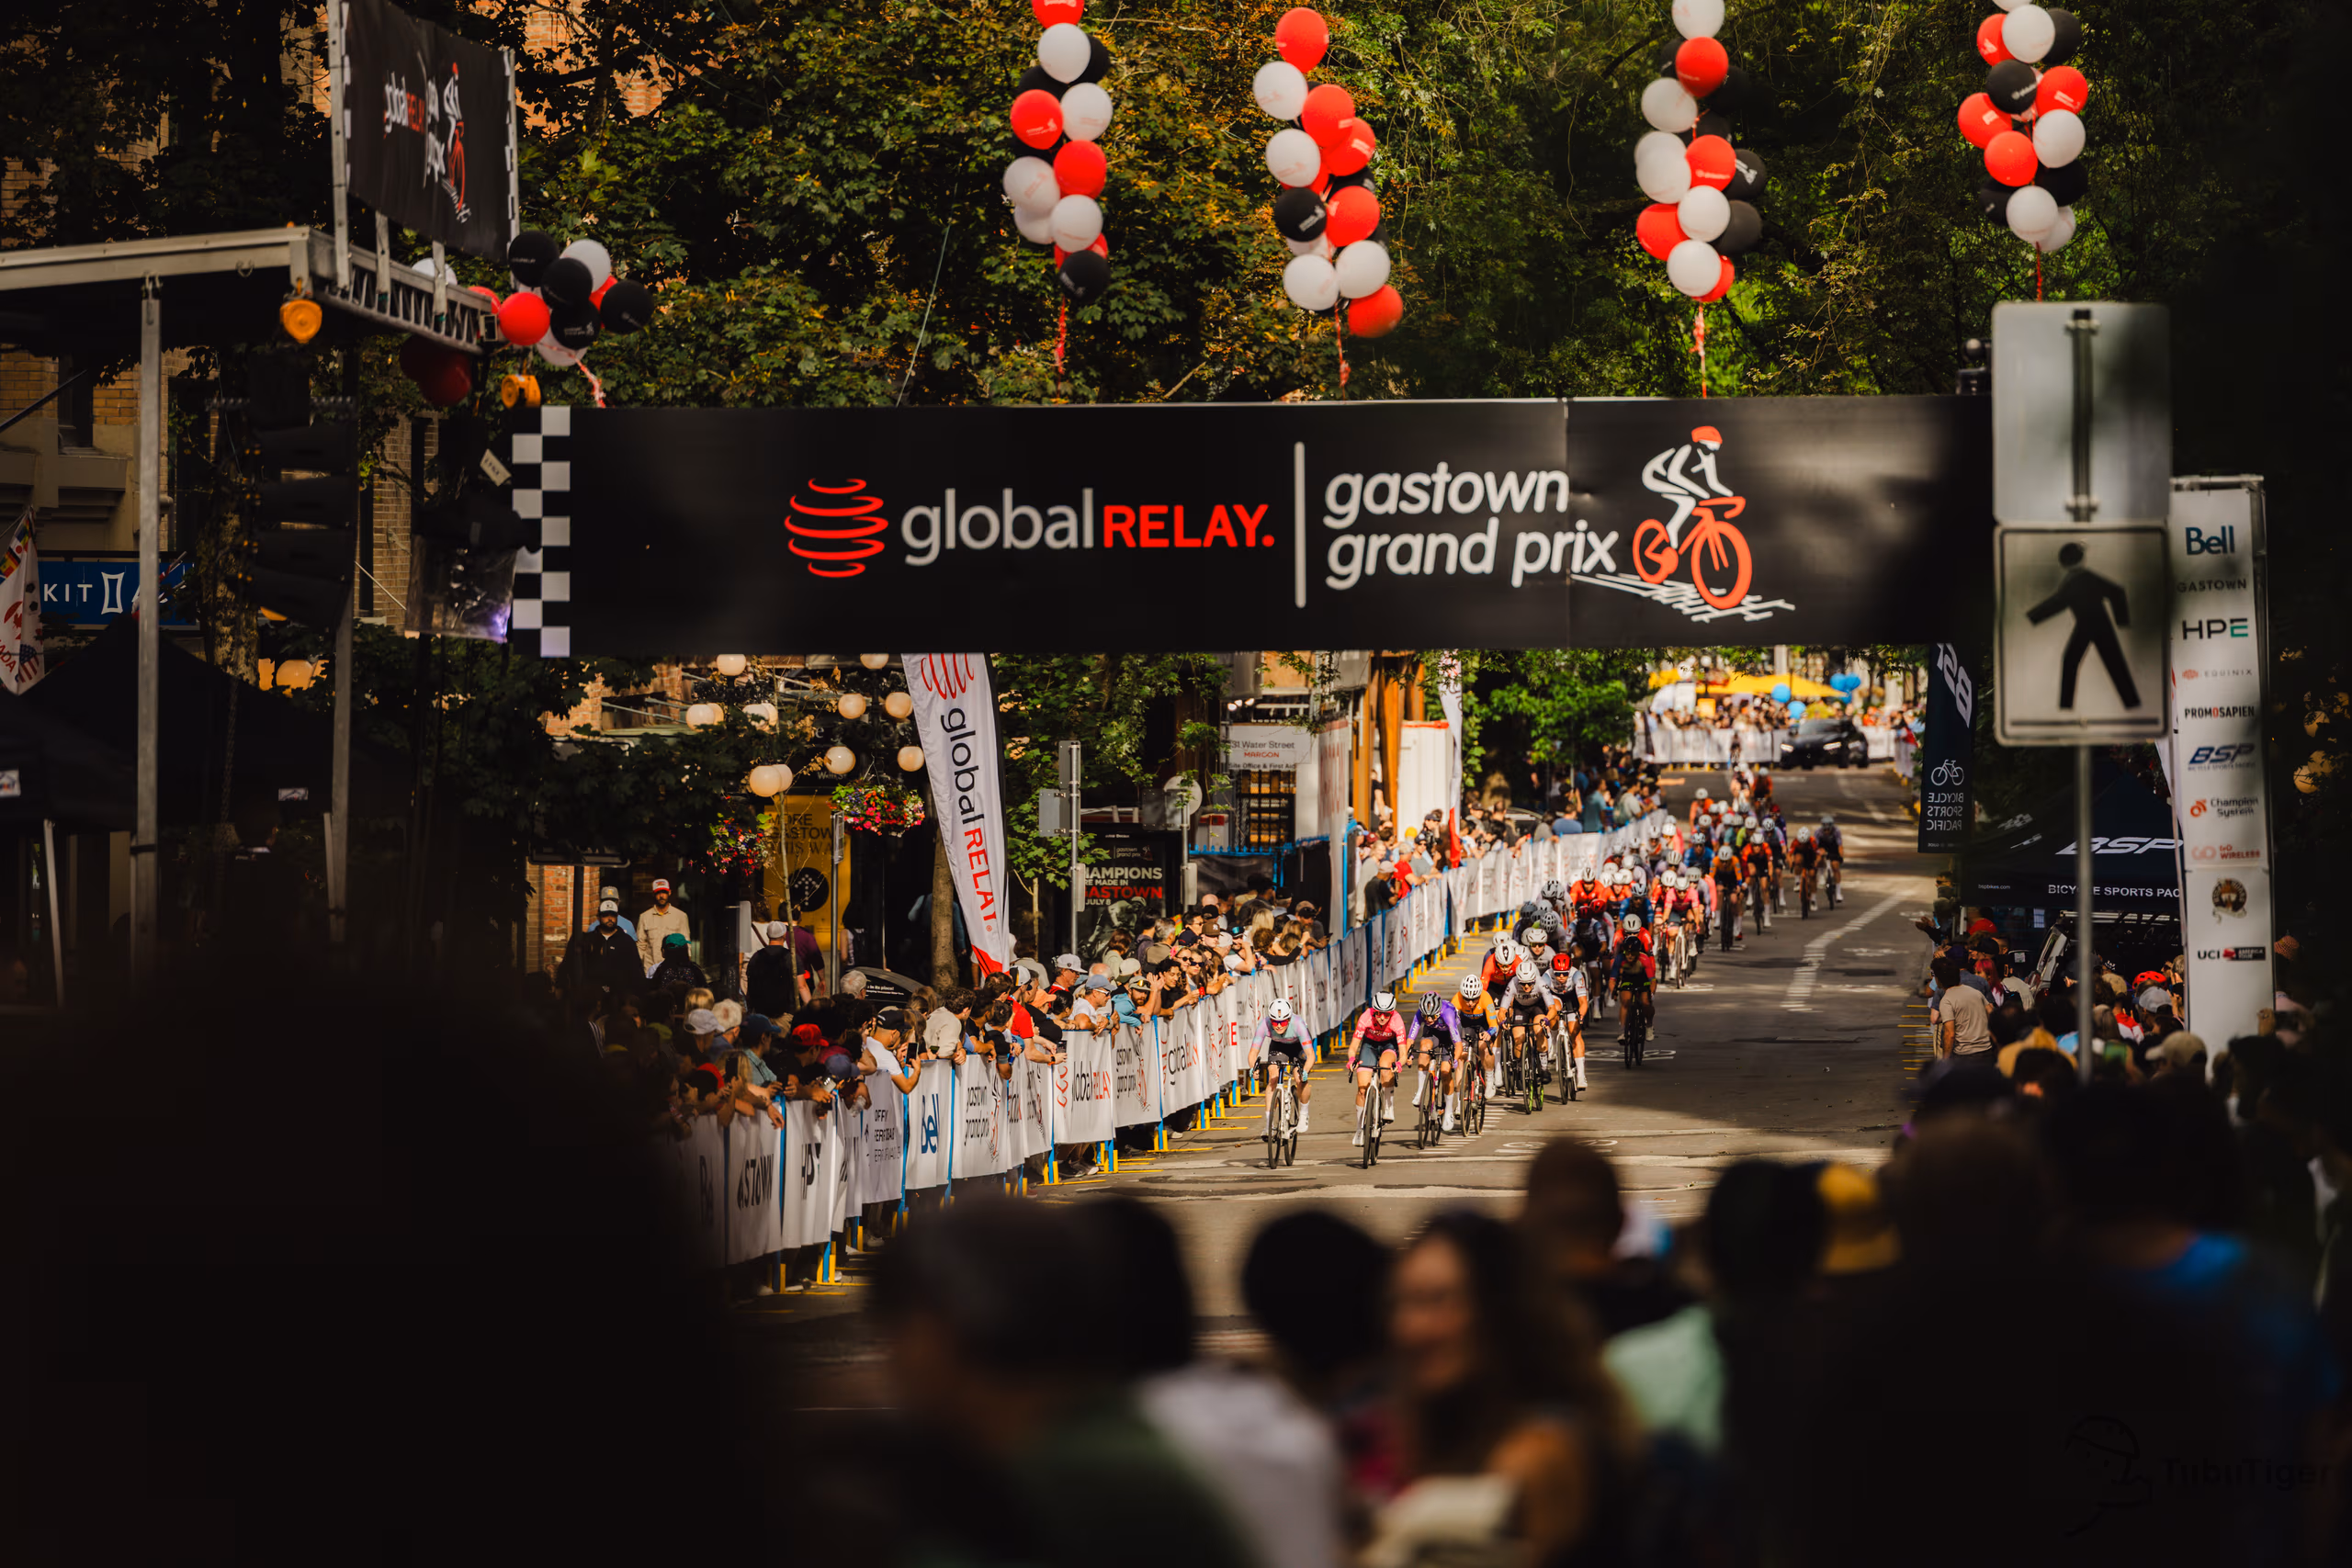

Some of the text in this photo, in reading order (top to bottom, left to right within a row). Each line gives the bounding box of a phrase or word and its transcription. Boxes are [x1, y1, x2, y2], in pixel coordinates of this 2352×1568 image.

[1323, 461, 1569, 530] gastown
[2185, 525, 2235, 556] Bell
[1326, 516, 1619, 590] grand prix
[43, 583, 93, 603] KIT
[2177, 579, 2247, 593] GASTOWN
[2182, 617, 2248, 640] HPE
[2204, 669, 2253, 678] EQUINIX
[2184, 705, 2255, 719] PROMOSAPIEN
[1242, 740, 1266, 749] Water
[1269, 740, 1295, 749] Street
[2188, 743, 2255, 764] BSP
[2055, 836, 2184, 855] BSP
[1085, 867, 1163, 880] HAMPIONS
[2104, 886, 2154, 897] SPORTS
[2198, 949, 2221, 960] UCI
[737, 1153, 775, 1211] ASTOWN
